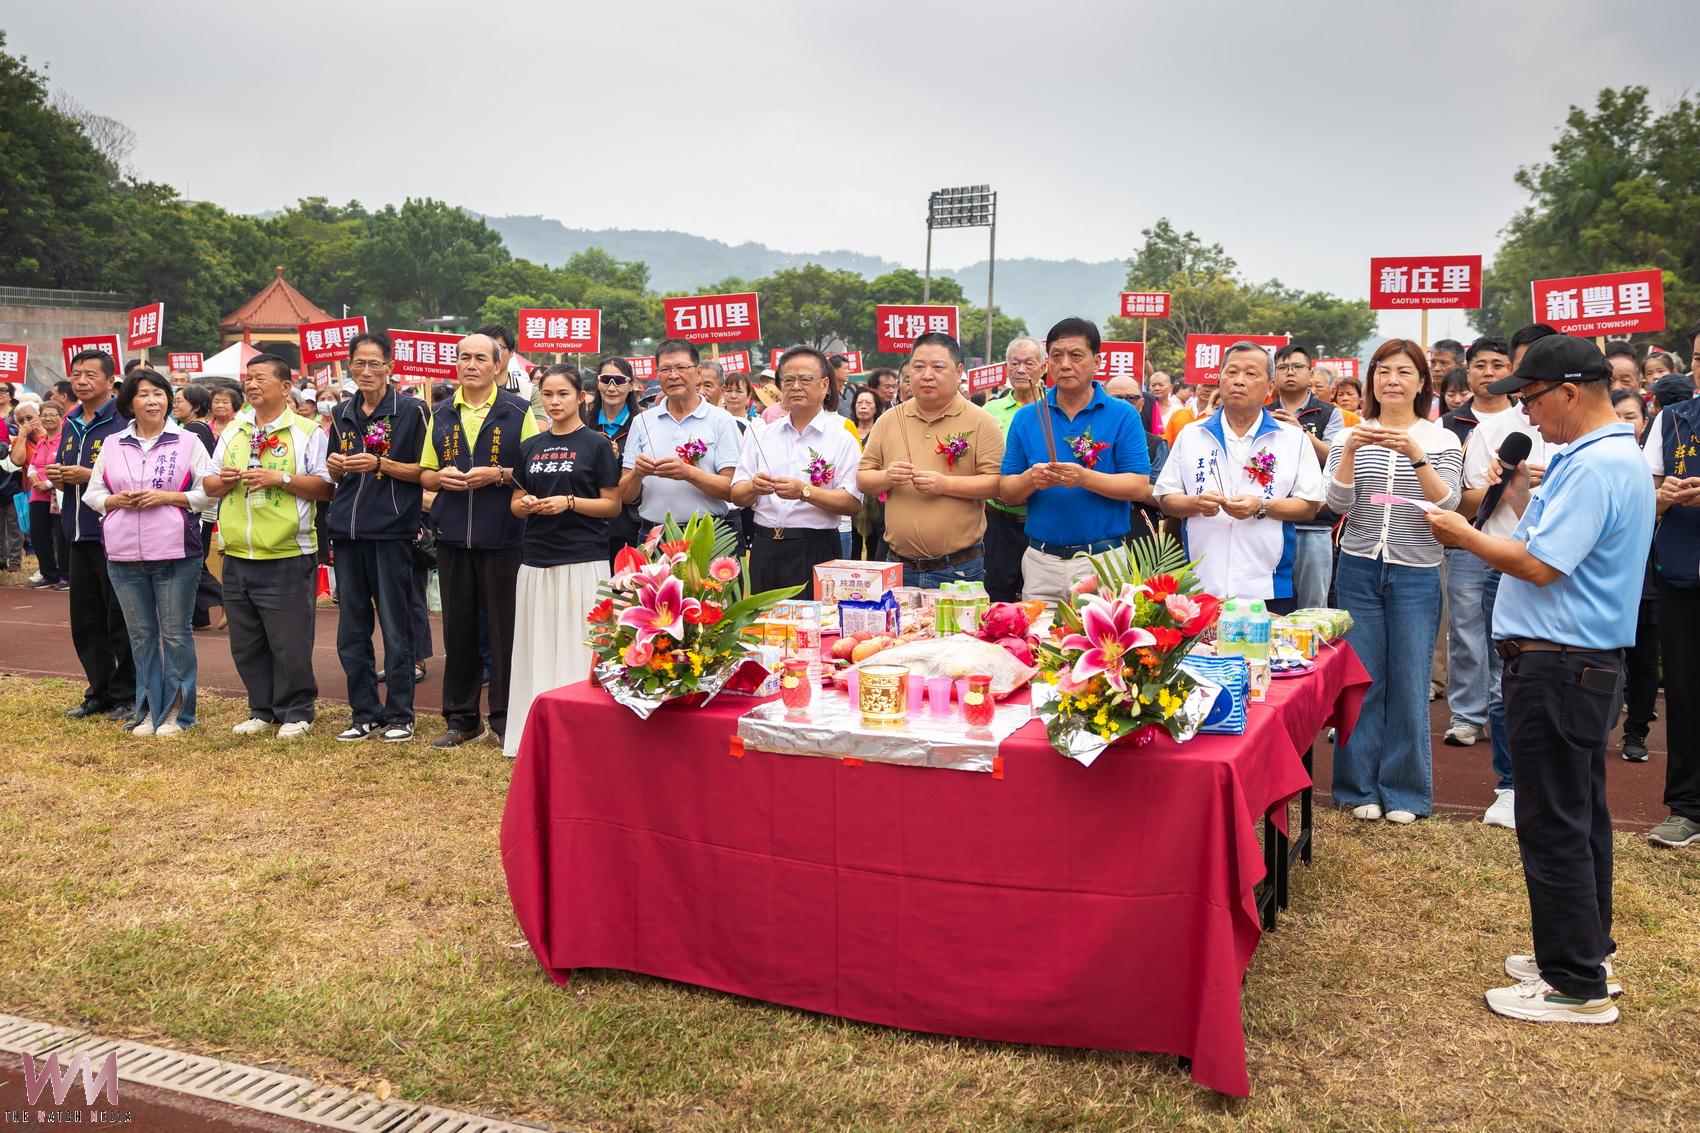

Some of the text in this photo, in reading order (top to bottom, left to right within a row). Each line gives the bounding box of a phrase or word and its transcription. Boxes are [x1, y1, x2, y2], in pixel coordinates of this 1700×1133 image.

[1380, 266, 1471, 293] 新庄里
[1546, 282, 1652, 321] 新豐里
[526, 317, 592, 339] 碧峰里
[673, 303, 750, 330] 石川里
[884, 314, 949, 339] 北投里
[1561, 319, 1639, 333] CAOTUN TOWNSHIP
[529, 460, 574, 474] 林友友
